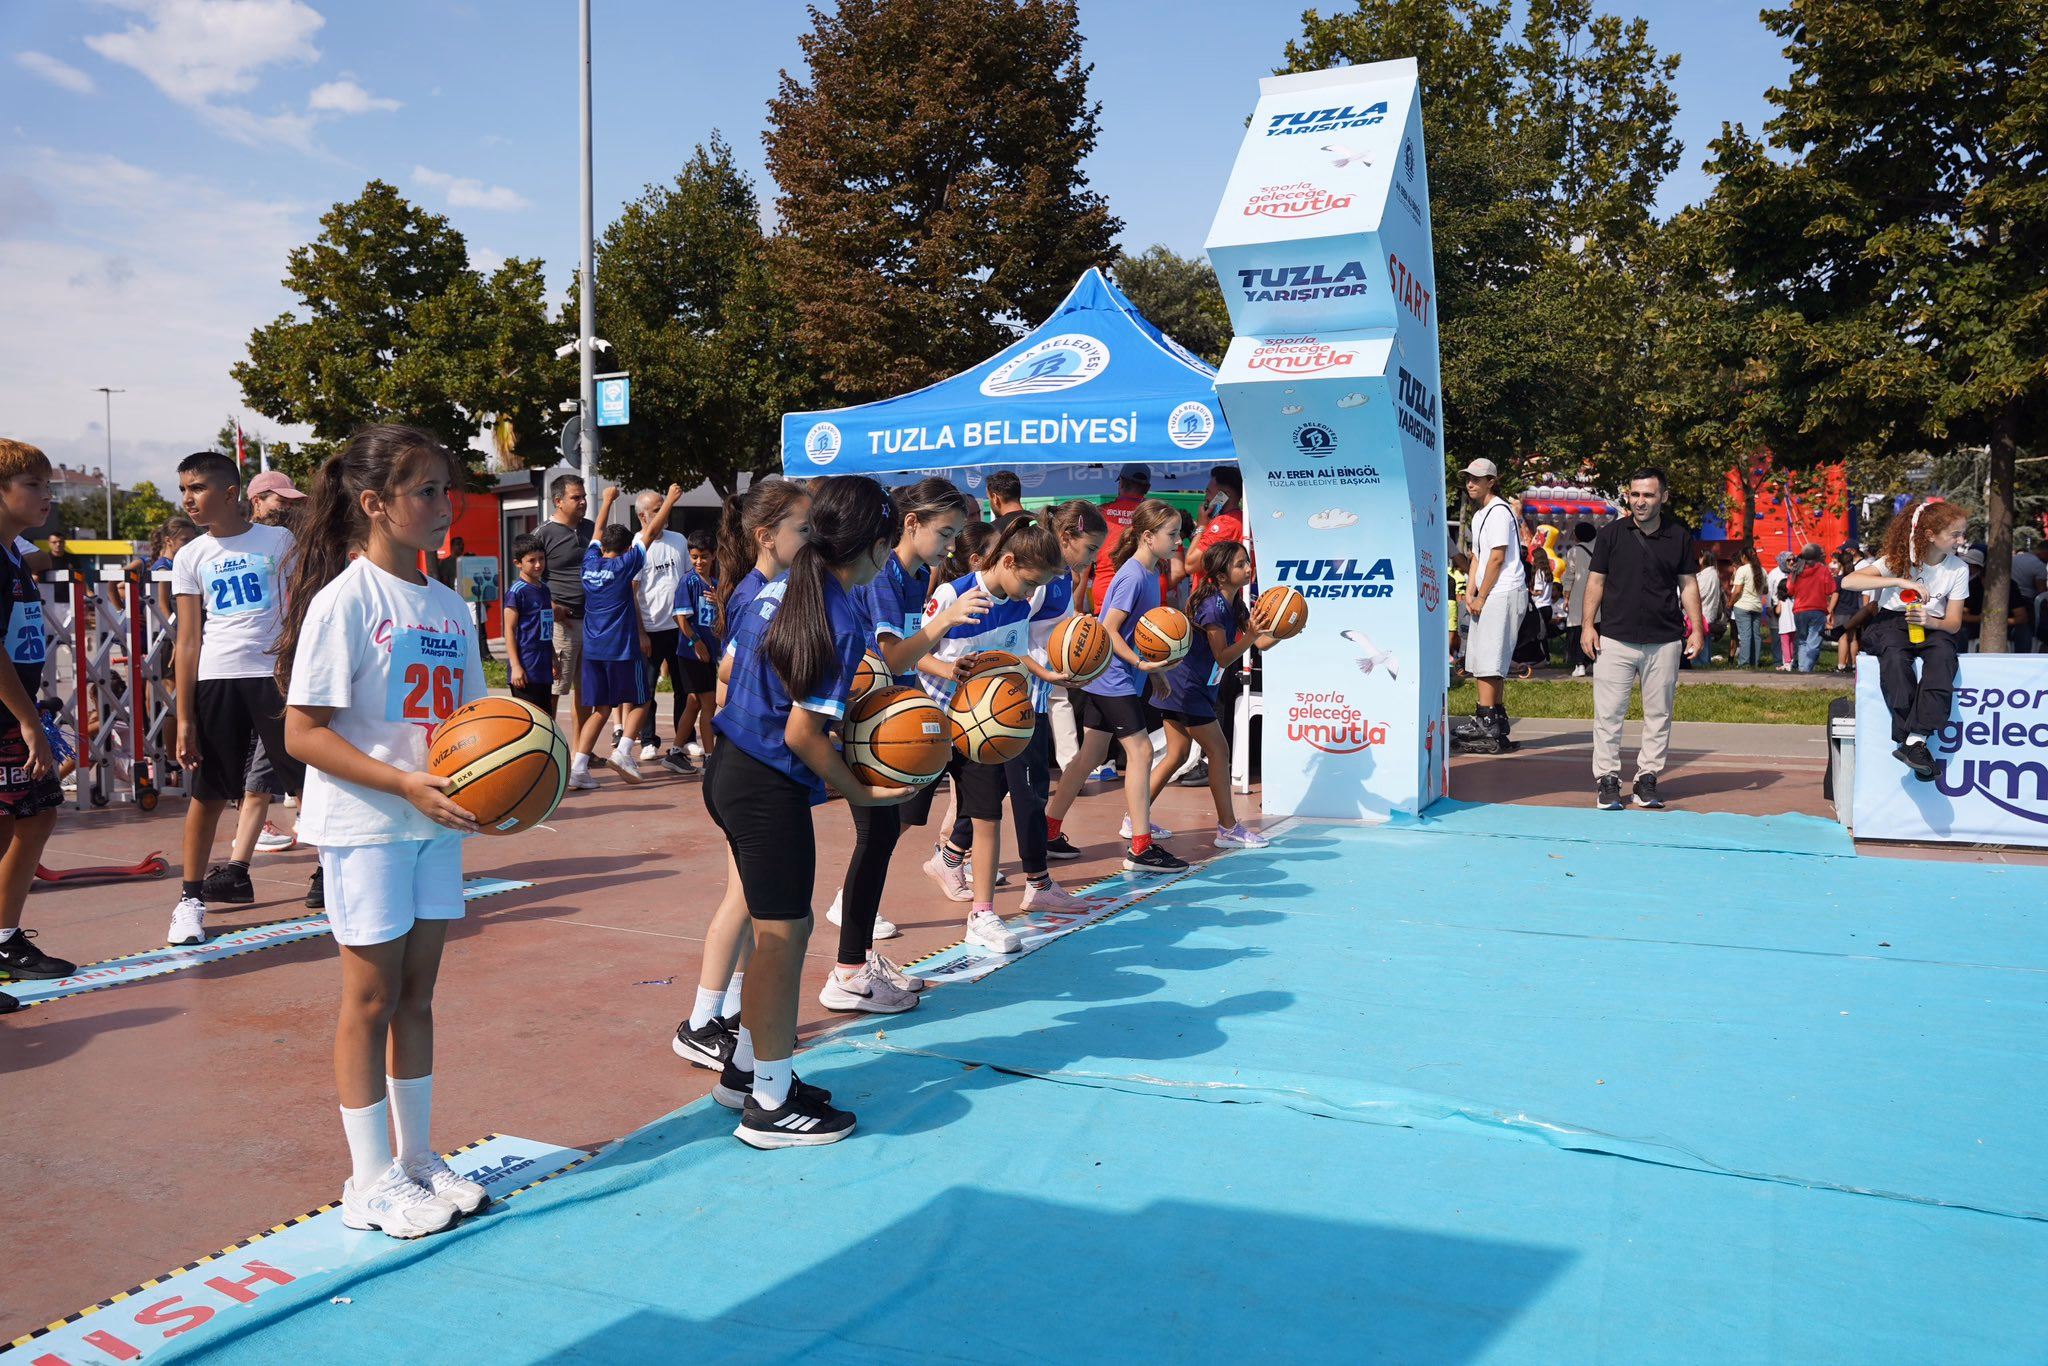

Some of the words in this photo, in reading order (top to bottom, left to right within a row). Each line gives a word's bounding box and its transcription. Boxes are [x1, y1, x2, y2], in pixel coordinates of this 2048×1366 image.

[1268, 101, 1388, 127] TUZLA
[1248, 188, 1327, 205] geleceğe
[1260, 181, 1312, 194] sporla
[1243, 194, 1351, 216] umutla
[1238, 261, 1367, 288] TUZLA
[1244, 283, 1367, 303] YARIŞIYOR
[1389, 253, 1431, 328] START
[1253, 343, 1330, 357] geleceğe
[1264, 336, 1317, 346] sporla
[1248, 350, 1354, 369] umutla
[1398, 365, 1436, 427] TUZLA
[868, 425, 956, 454] TUZLA
[963, 411, 1137, 447] BELEDİYESİ
[1398, 406, 1436, 451] YARIŞIYOR
[1267, 470, 1285, 480] AV.
[1286, 469, 1314, 479] EREN
[1317, 466, 1335, 478] ALİ
[1337, 465, 1380, 477] BİNGÖL
[1268, 480, 1296, 488] TUZLA
[1340, 477, 1381, 486] BAŞKANI
[1275, 558, 1395, 582] TUZLA
[211, 572, 263, 610] 216
[1287, 584, 1394, 600] ARIŞIYOR
[420, 635, 458, 650] TUZLA
[1073, 621, 1092, 658] HELIX
[403, 663, 464, 720] 267
[1295, 691, 1345, 705] sporla
[1288, 703, 1362, 723] geleceğe
[1287, 719, 1387, 745] umutla
[1937, 711, 2048, 754] gelec
[463, 1154, 526, 1181] ZLA
